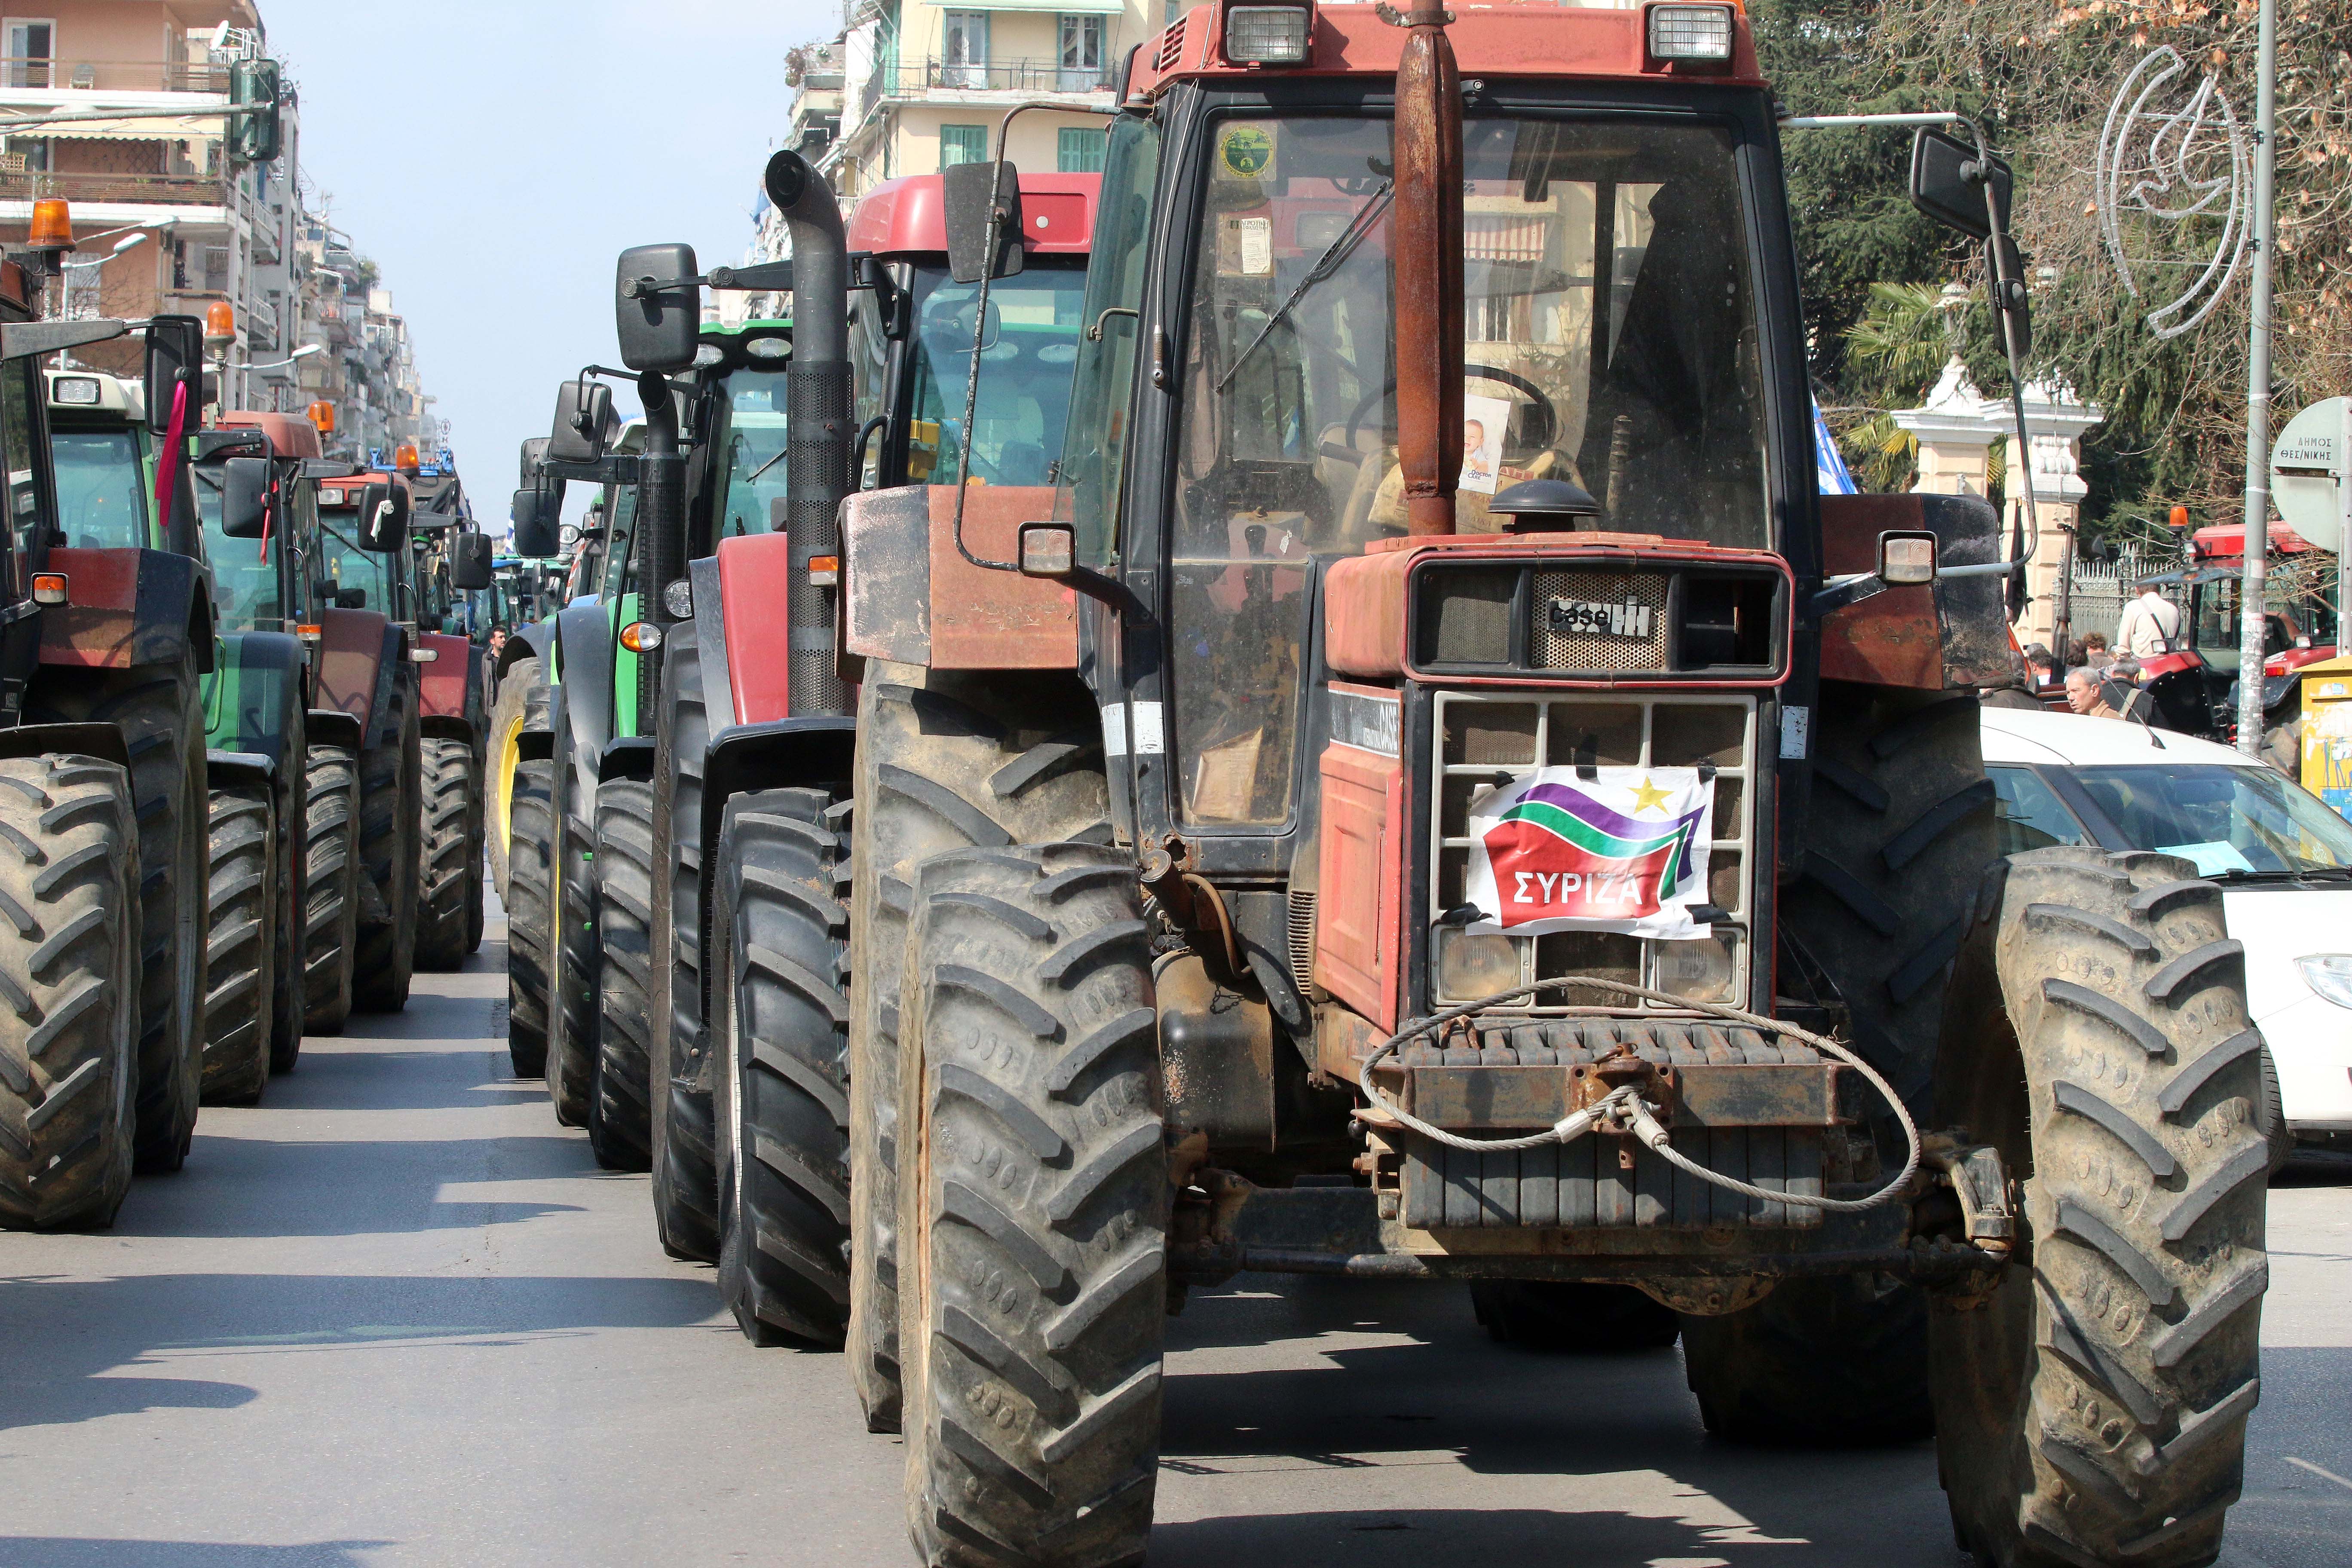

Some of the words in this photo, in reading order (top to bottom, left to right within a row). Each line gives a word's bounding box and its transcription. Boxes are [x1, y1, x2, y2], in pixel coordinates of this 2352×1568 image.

[2298, 437, 2331, 447] ΔΗΜΟΣ
[2281, 450, 2331, 460] ΘΕΣ/ΝΙΚΗΣ
[1471, 470, 1491, 478] DOCTOR
[1380, 704, 1397, 751] CASE
[1513, 871, 1643, 905] ΣΥΡΙΖΑ
